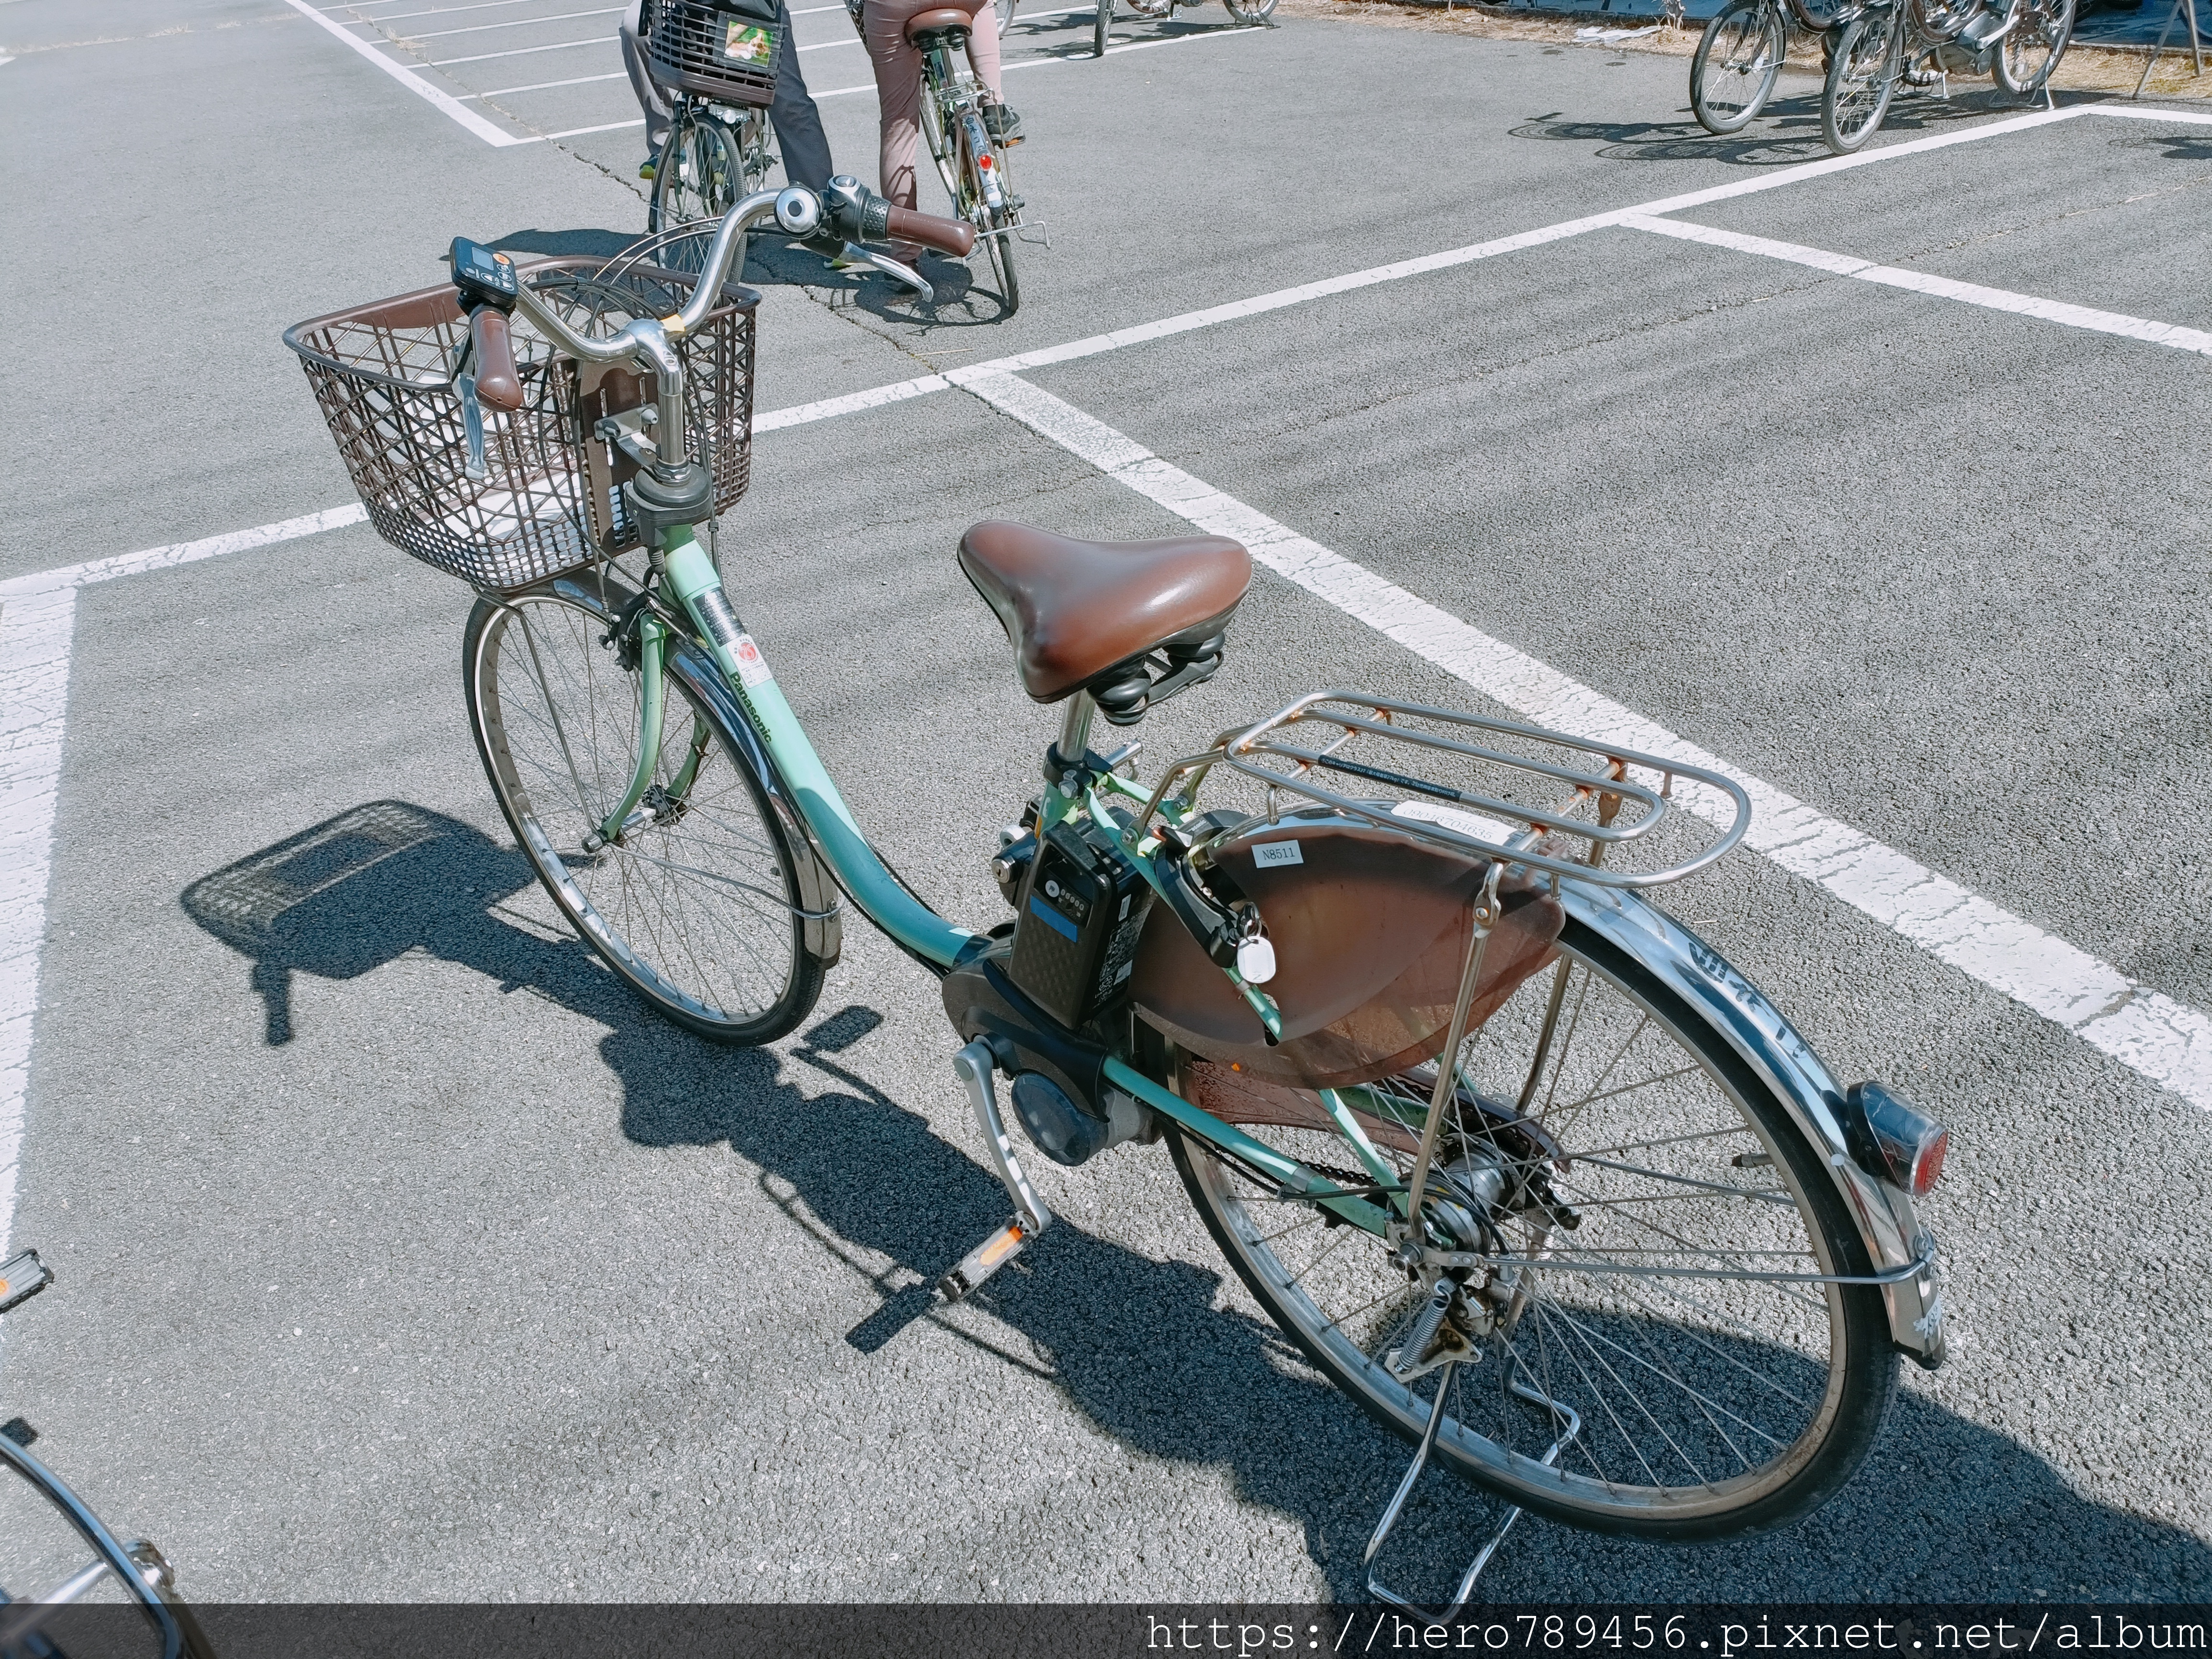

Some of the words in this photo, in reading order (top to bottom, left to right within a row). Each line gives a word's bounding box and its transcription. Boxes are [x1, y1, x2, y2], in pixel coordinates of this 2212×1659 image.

[729, 671, 772, 744] Panasonic
[1403, 808, 1494, 840] 09046704635
[1261, 847, 1295, 860] N8511
